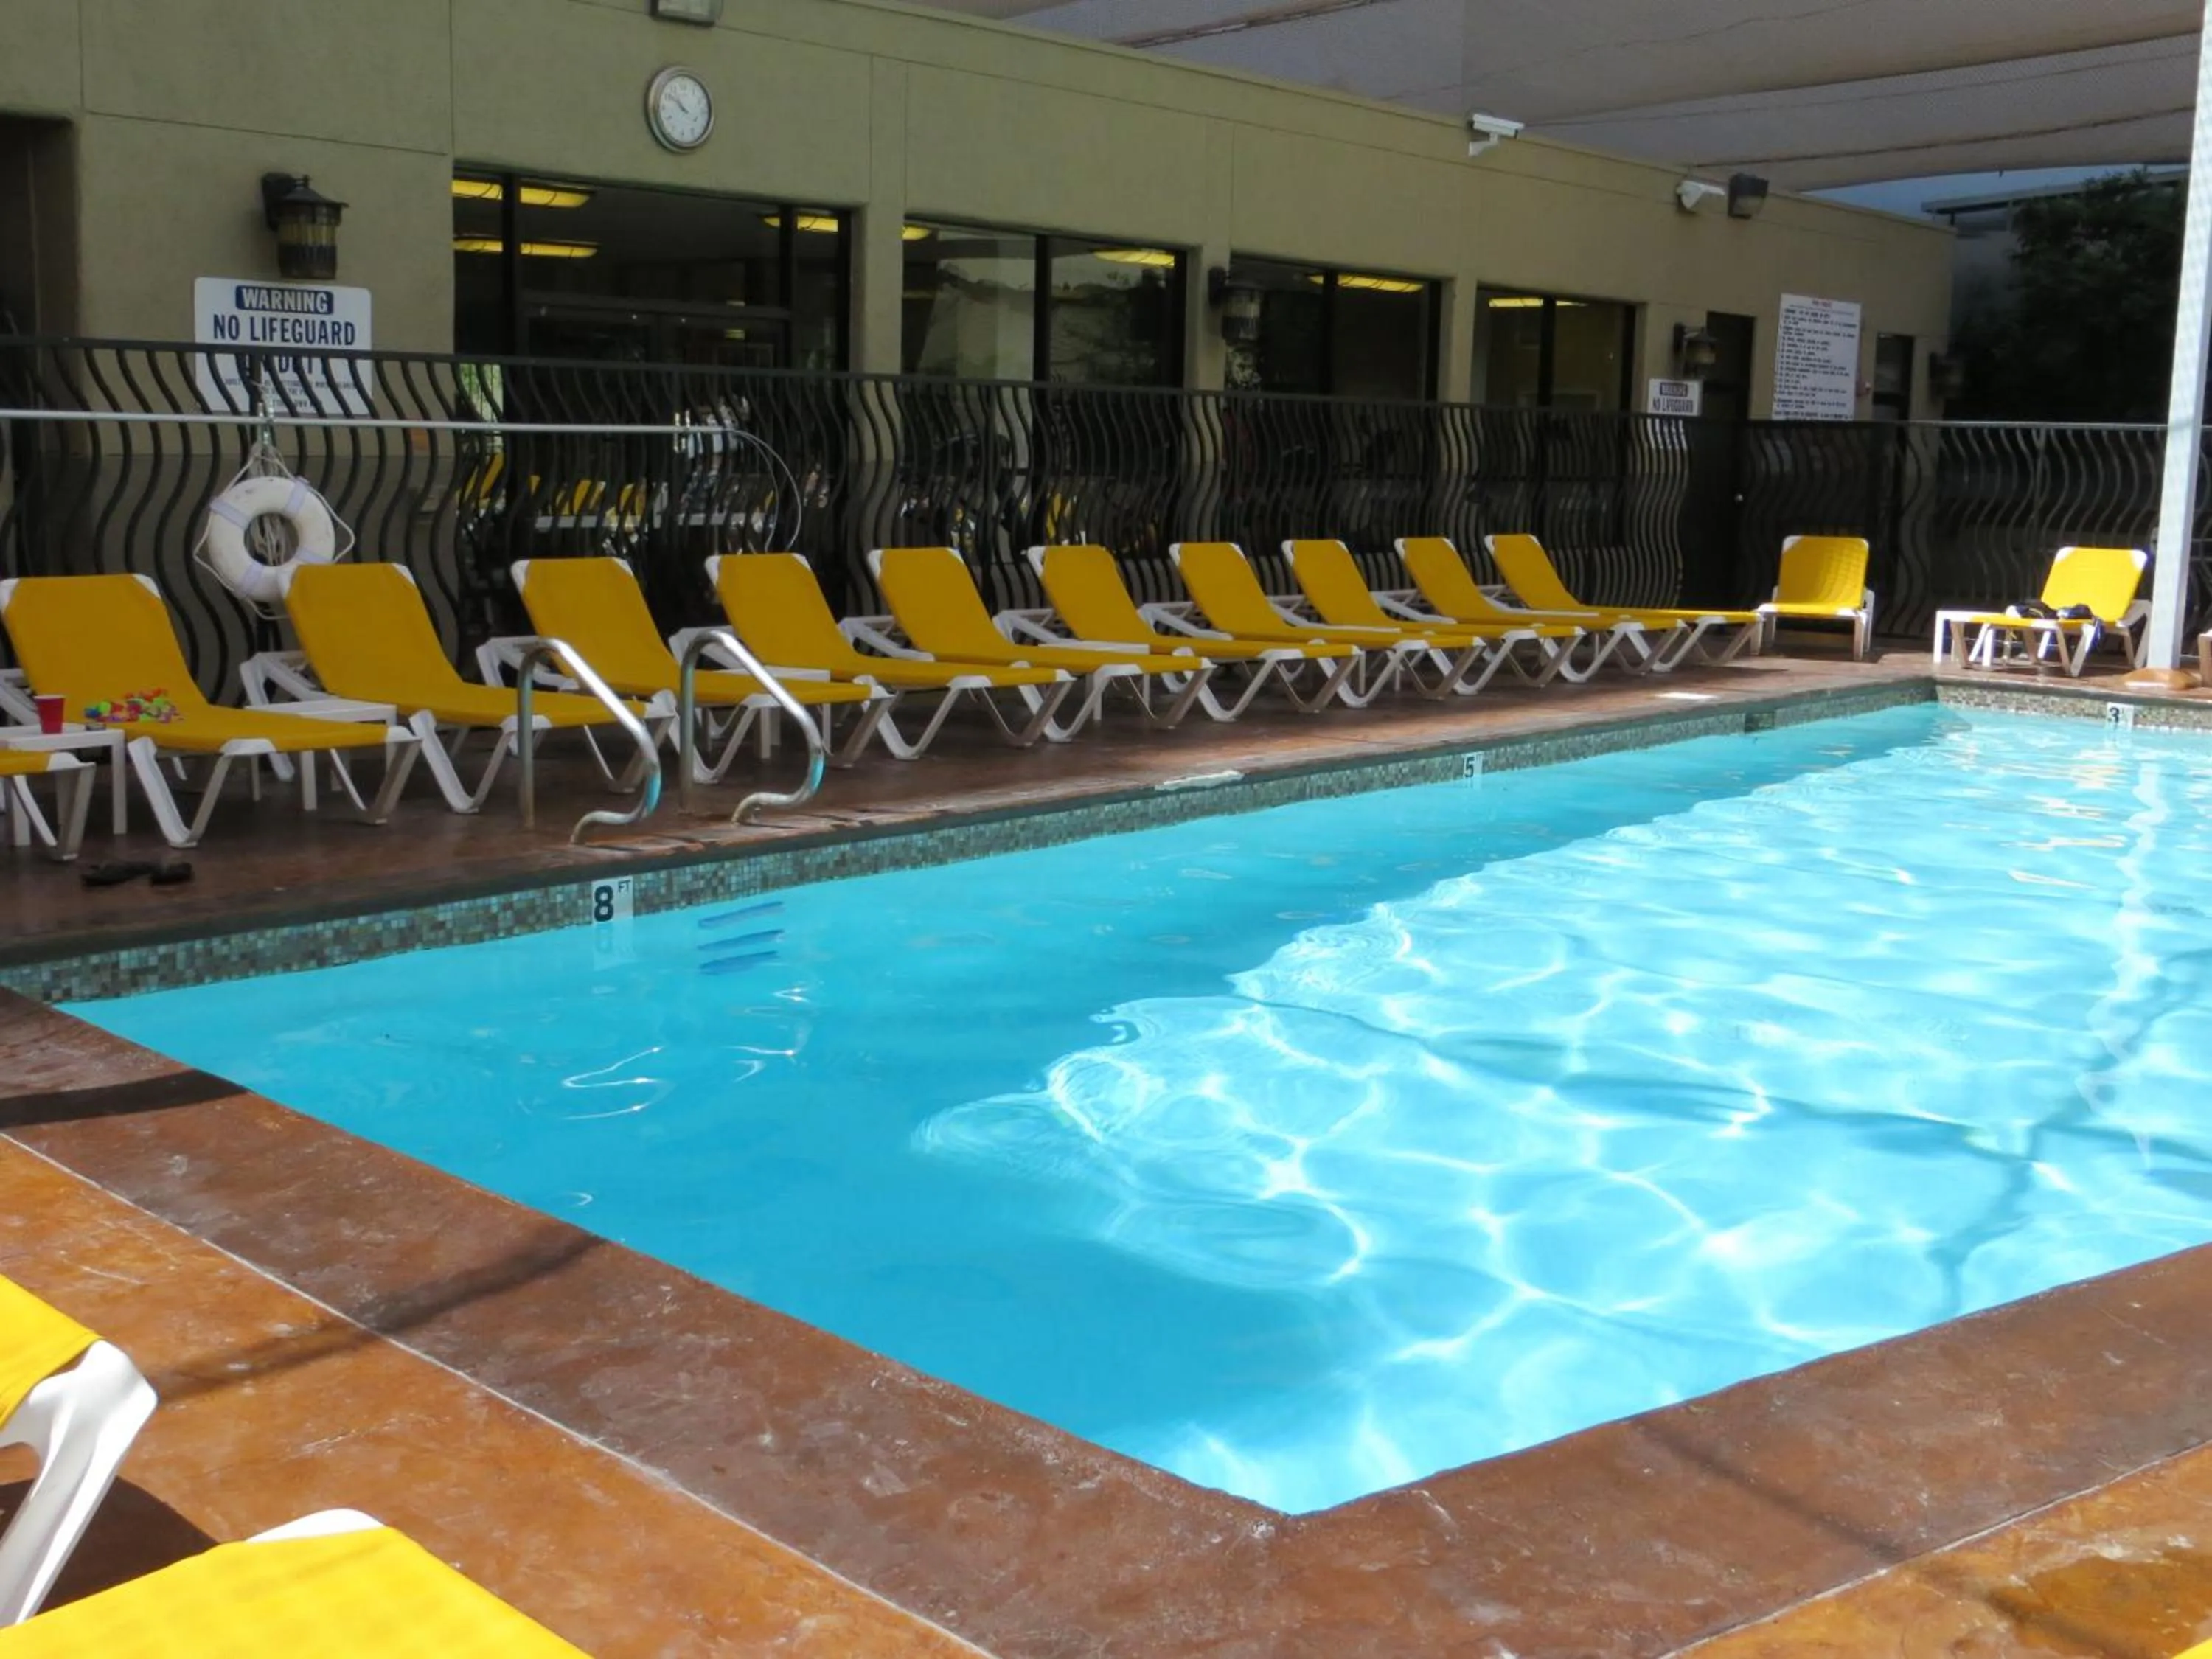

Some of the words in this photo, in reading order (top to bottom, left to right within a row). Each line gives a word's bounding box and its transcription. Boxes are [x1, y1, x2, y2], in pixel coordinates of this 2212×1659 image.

[242, 288, 328, 313] WARNING
[213, 314, 240, 341] NO
[250, 316, 355, 346] LIFEGUARD
[2108, 707, 2120, 724] 3
[1465, 756, 1475, 778] 5
[594, 885, 614, 922] 8
[618, 880, 631, 893] FT
